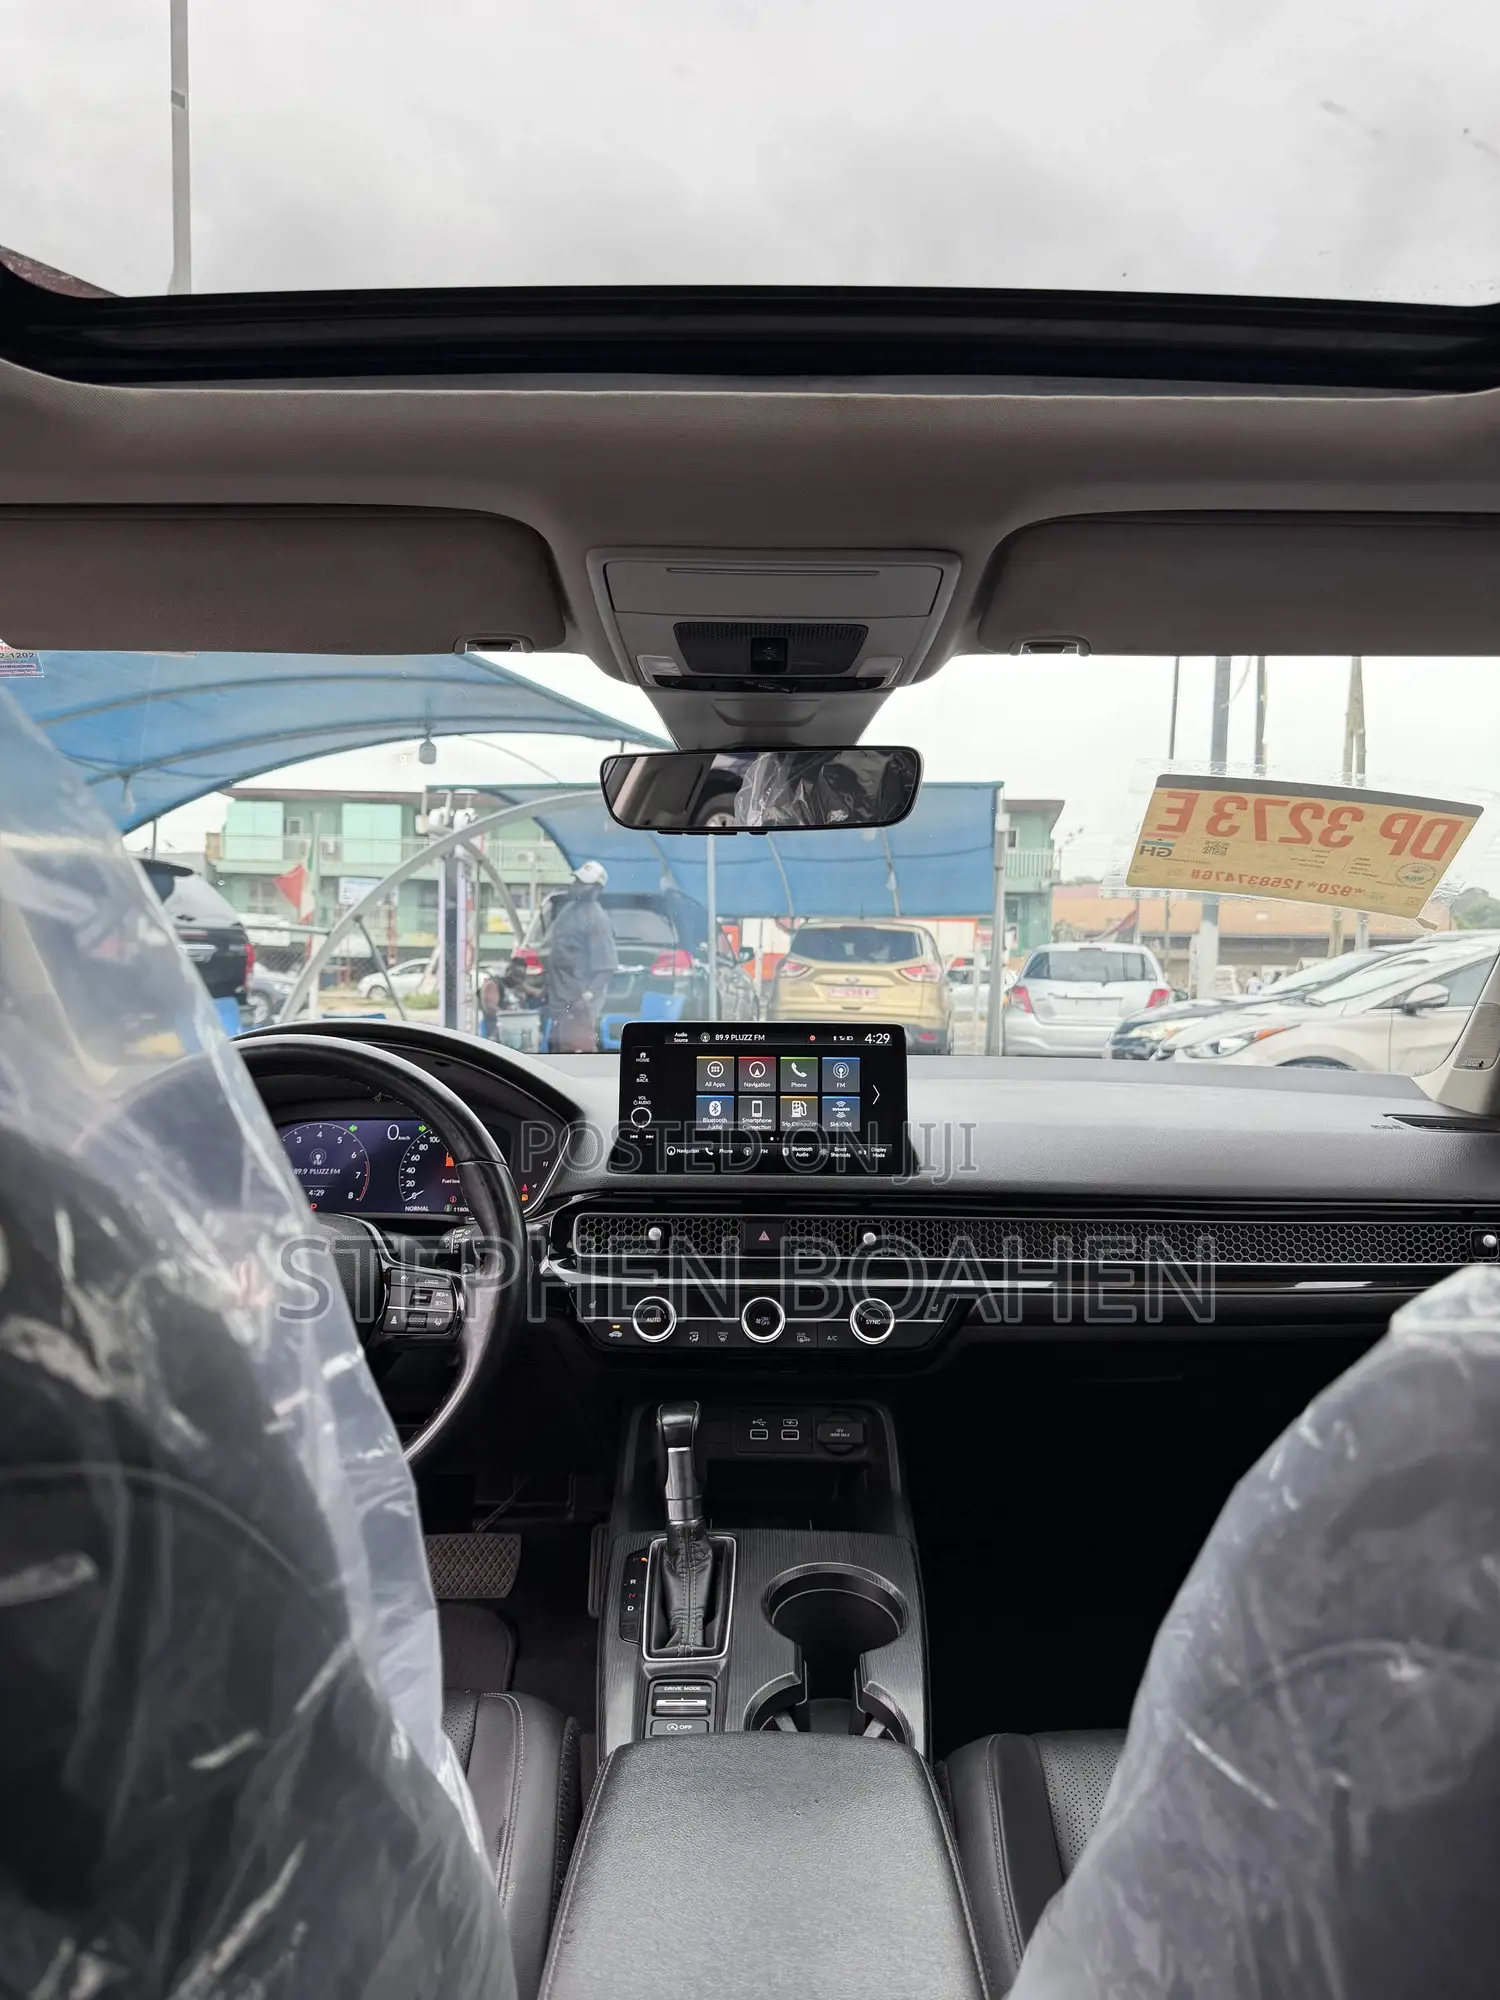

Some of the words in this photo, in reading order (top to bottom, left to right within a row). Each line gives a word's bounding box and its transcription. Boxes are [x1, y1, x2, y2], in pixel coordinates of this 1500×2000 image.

[864, 1033, 891, 1044] 4:29
[296, 1136, 302, 1144] 3
[337, 1136, 343, 1144] 5
[418, 1143, 429, 1151] 80
[351, 1151, 357, 1159] 6
[410, 1154, 421, 1162] 60
[405, 1166, 416, 1174] 40
[355, 1171, 361, 1179] 7
[405, 1180, 416, 1188] 20
[308, 1189, 325, 1197] 4:29
[347, 1191, 354, 1199] 8
